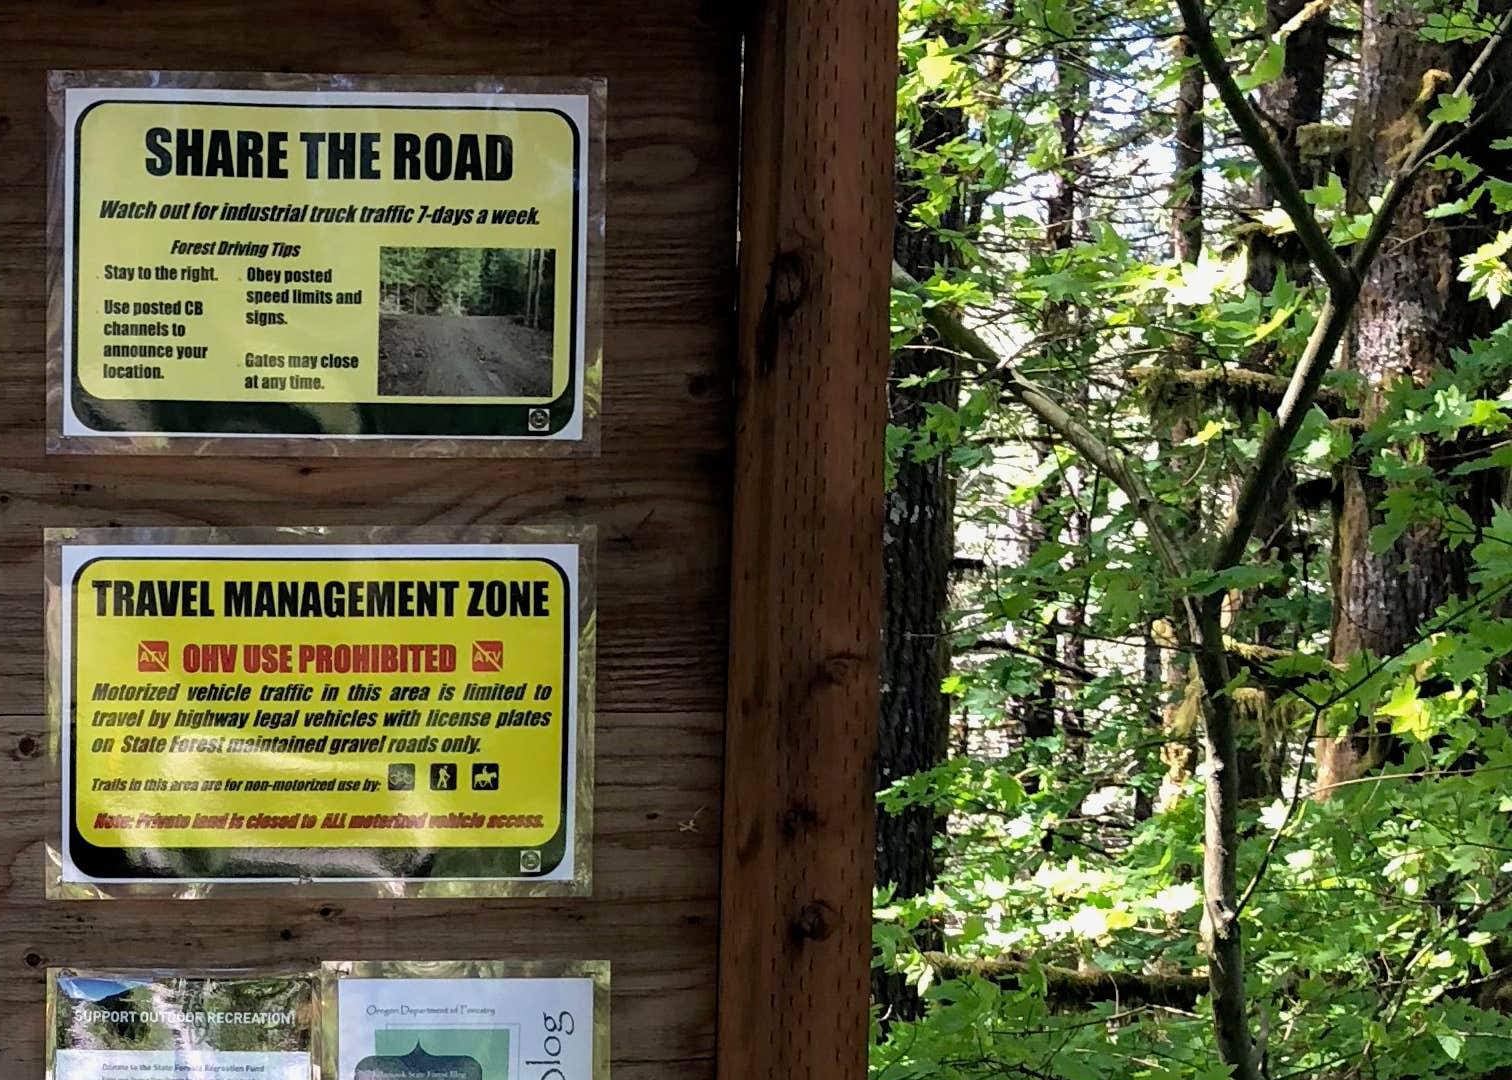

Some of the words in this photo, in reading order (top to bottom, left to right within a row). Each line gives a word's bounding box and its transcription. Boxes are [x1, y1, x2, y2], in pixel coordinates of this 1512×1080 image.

[145, 127, 288, 179] SHARE
[299, 131, 381, 180] THE
[393, 132, 513, 181] ROAD
[99, 199, 157, 219] Watch
[158, 202, 191, 220] out
[191, 201, 219, 220] for
[219, 202, 309, 222] industrial
[308, 204, 358, 223] truck
[359, 204, 415, 224] traffic
[416, 205, 475, 226] 7-days
[475, 208, 489, 224] a
[490, 206, 540, 225] week.
[170, 239, 216, 255] Forest
[216, 240, 269, 258] Driving
[271, 242, 301, 258] Tips
[104, 264, 135, 281] Stay
[137, 266, 152, 280] to
[154, 264, 178, 280] the
[180, 265, 218, 283] right.
[246, 266, 281, 284] Obey
[284, 268, 332, 284] posted
[246, 288, 290, 305] speed
[292, 288, 333, 304] limits
[335, 289, 362, 305] and
[104, 299, 130, 314] Use
[132, 300, 182, 316] posted
[184, 300, 203, 316] CB
[245, 309, 288, 326] signs.
[103, 320, 169, 337] channels
[171, 322, 186, 337] to
[103, 344, 173, 358] announce
[176, 345, 208, 360] your
[244, 352, 285, 368] Gates
[287, 355, 318, 370] may
[320, 353, 359, 369] close
[102, 363, 164, 379] location.
[244, 374, 259, 389] at
[261, 376, 287, 391] any
[289, 374, 325, 390] time.
[91, 580, 215, 617] TRAVEL
[224, 580, 460, 618] MANAGEMENT
[466, 580, 549, 617] ZONE
[183, 643, 238, 673] OHV
[243, 644, 292, 673] USE
[298, 644, 456, 673] PROHIBITED
[91, 682, 181, 701] Motorized
[186, 683, 252, 702] vehicle
[258, 683, 314, 702] traffic
[320, 683, 340, 702] in
[346, 683, 382, 702] this
[388, 686, 431, 701] area
[437, 682, 456, 701] is
[462, 682, 528, 701] limited
[533, 684, 553, 701] to
[73, 1010, 136, 1023] SUPPORT
